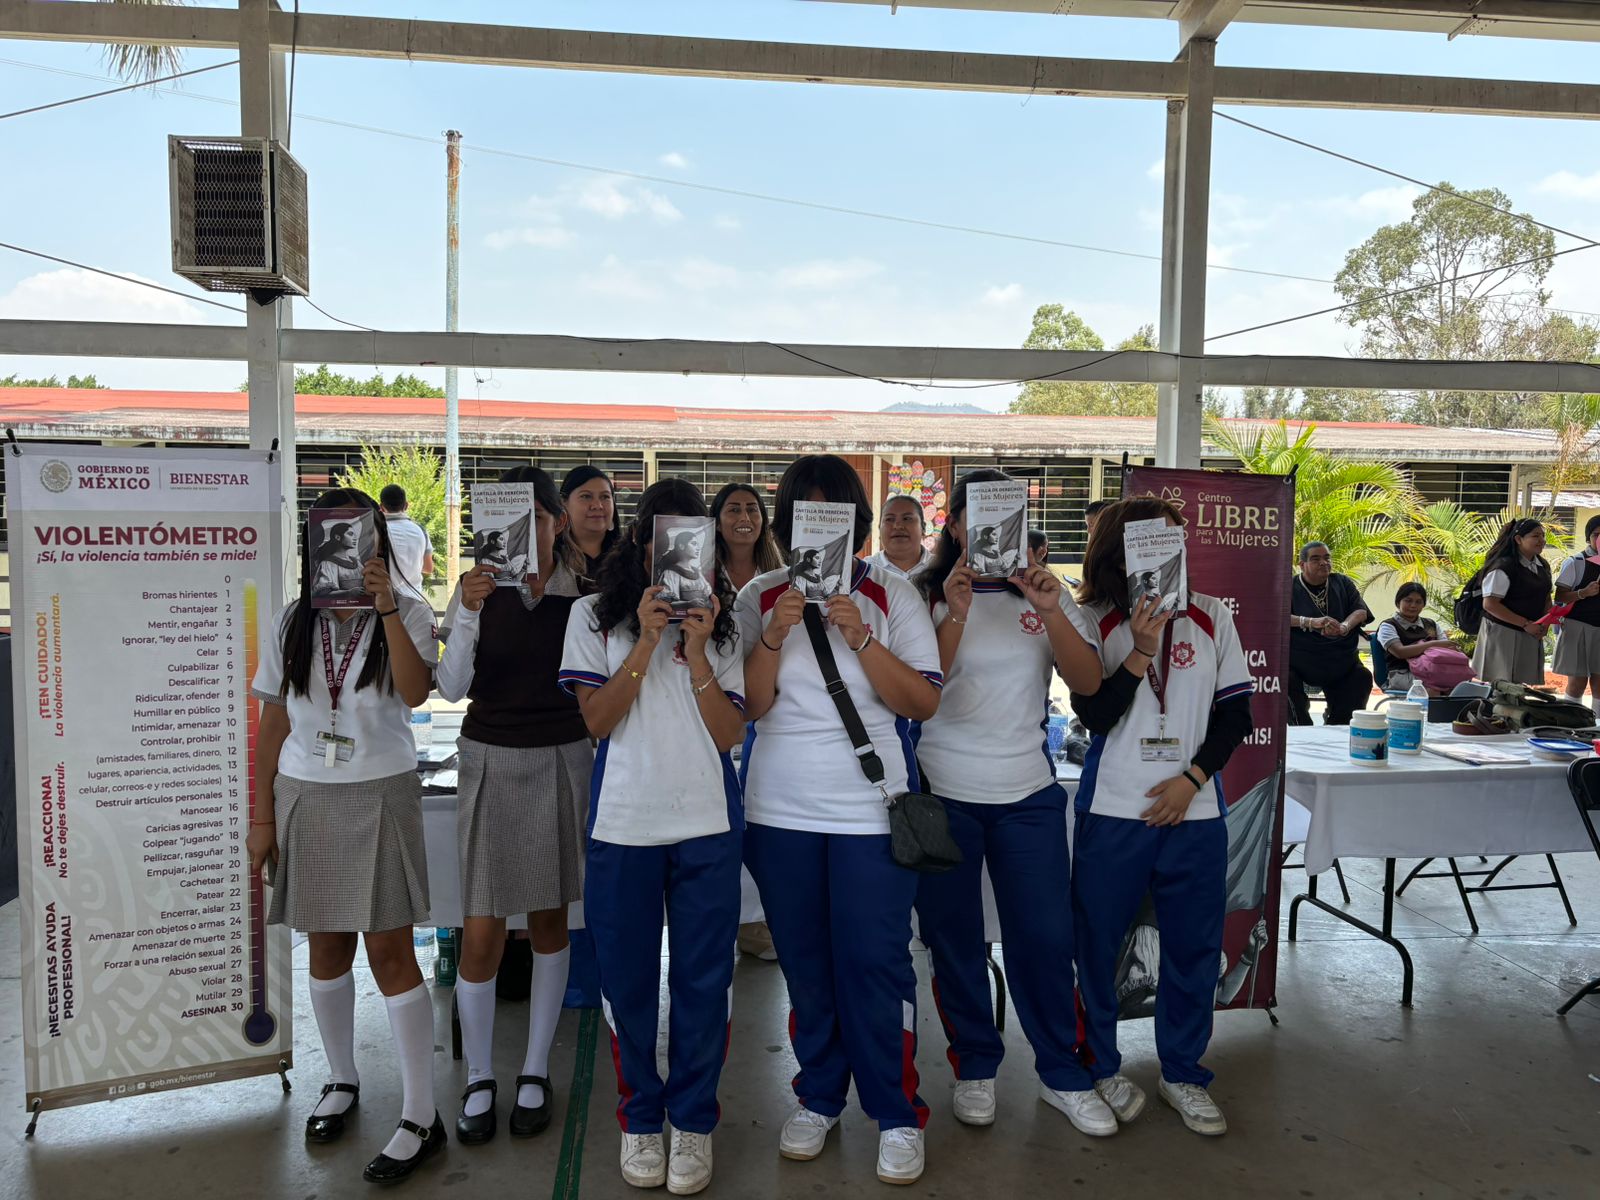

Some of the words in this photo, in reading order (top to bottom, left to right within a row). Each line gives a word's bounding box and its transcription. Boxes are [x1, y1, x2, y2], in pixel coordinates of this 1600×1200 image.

[79, 474, 150, 489] MÉXICO
[170, 473, 249, 485] BIENESTAR
[499, 496, 529, 504] Mujeres
[1198, 492, 1231, 503] Centro
[818, 515, 849, 524] Mujeres
[1197, 504, 1279, 530] LIBRE
[34, 521, 258, 546] VIOLENTÓMETRO
[1216, 530, 1278, 549] Mujeres
[37, 551, 57, 564] ¡Sí,
[61, 551, 74, 562] la
[78, 551, 140, 562] violencia
[143, 550, 199, 561] también
[203, 552, 218, 560] se
[221, 550, 257, 560] mide!
[170, 605, 218, 614] Chantajear
[50, 592, 61, 663] aumentará.
[182, 620, 218, 629] engañar
[37, 612, 49, 683] CUIDADO!
[122, 637, 157, 645] Ignorar,
[196, 648, 218, 656] Celar
[1244, 650, 1267, 667] ICA
[168, 663, 219, 672] Culpabilizar
[169, 677, 220, 686] Descalificar
[1250, 676, 1281, 693] GICA
[52, 666, 63, 720] violencia
[136, 693, 184, 703] Ridiculizar,
[186, 692, 220, 700] ofender
[39, 687, 52, 719] ¡TEN
[134, 708, 172, 717] Humillar
[188, 706, 221, 716] público
[55, 722, 64, 737] La
[132, 723, 175, 732] Intimidar,
[177, 721, 221, 729] amenazar
[141, 737, 184, 747] Controlar,
[187, 734, 221, 745] prohibir
[96, 754, 146, 765] (amistades,
[147, 751, 191, 761] familiares,
[192, 750, 222, 758] dinero,
[227, 746, 237, 755] 12
[88, 771, 122, 780] lugares,
[124, 766, 171, 777] apariencia,
[172, 764, 222, 773] actividades,
[228, 761, 237, 769] 13
[56, 761, 65, 818] destruir.
[79, 786, 110, 794] celular,
[112, 783, 153, 792] correos-e
[162, 780, 185, 788] redes
[186, 777, 222, 786] sociales)
[228, 775, 238, 783] 14
[96, 798, 132, 808] Destruir
[134, 795, 173, 804] artículos
[175, 791, 222, 803] personales
[228, 789, 238, 797] 15
[180, 806, 222, 816] Manosear
[229, 803, 238, 811] 16
[42, 776, 56, 868] ¡REACCIONA!
[146, 823, 180, 833] Caricias
[183, 820, 223, 831] agresivas
[57, 820, 69, 846] dejes
[143, 839, 178, 848] Golpear
[60, 848, 67, 859] te
[144, 853, 182, 862] Pellizcar,
[185, 848, 224, 858] rasguñar
[230, 846, 239, 854] 19
[59, 861, 68, 878] No
[147, 866, 187, 876] Empujar,
[188, 863, 224, 874] jalonear
[229, 860, 240, 868] 20
[180, 877, 224, 887] Cachetear
[230, 874, 239, 882] 21
[197, 891, 224, 900] Patear
[230, 888, 240, 896] 22
[160, 909, 200, 919] Encerrar,
[202, 905, 224, 914] aislar
[230, 903, 241, 911] 23
[46, 902, 56, 951] AYUDA
[89, 930, 135, 942] Amenazar
[137, 929, 154, 937] con
[156, 925, 189, 936] objetos
[230, 917, 241, 925] 24
[132, 940, 177, 952] Amenazar
[180, 937, 191, 946] de
[194, 934, 225, 944] muerte
[104, 960, 132, 970] Forzar
[161, 952, 197, 963] relación
[198, 948, 225, 958] sexual
[230, 946, 242, 954] 26
[62, 915, 74, 1019] PROFESIONAL!
[169, 967, 197, 976] Abuso
[198, 962, 226, 972] sexual
[230, 960, 242, 968] 27
[202, 977, 226, 986] Violar
[231, 975, 242, 983] 28
[47, 954, 61, 1038] ¡NECESITAS
[196, 991, 226, 1002] Mutilar
[231, 989, 243, 997] 29
[181, 1006, 227, 1019] ASESINAR
